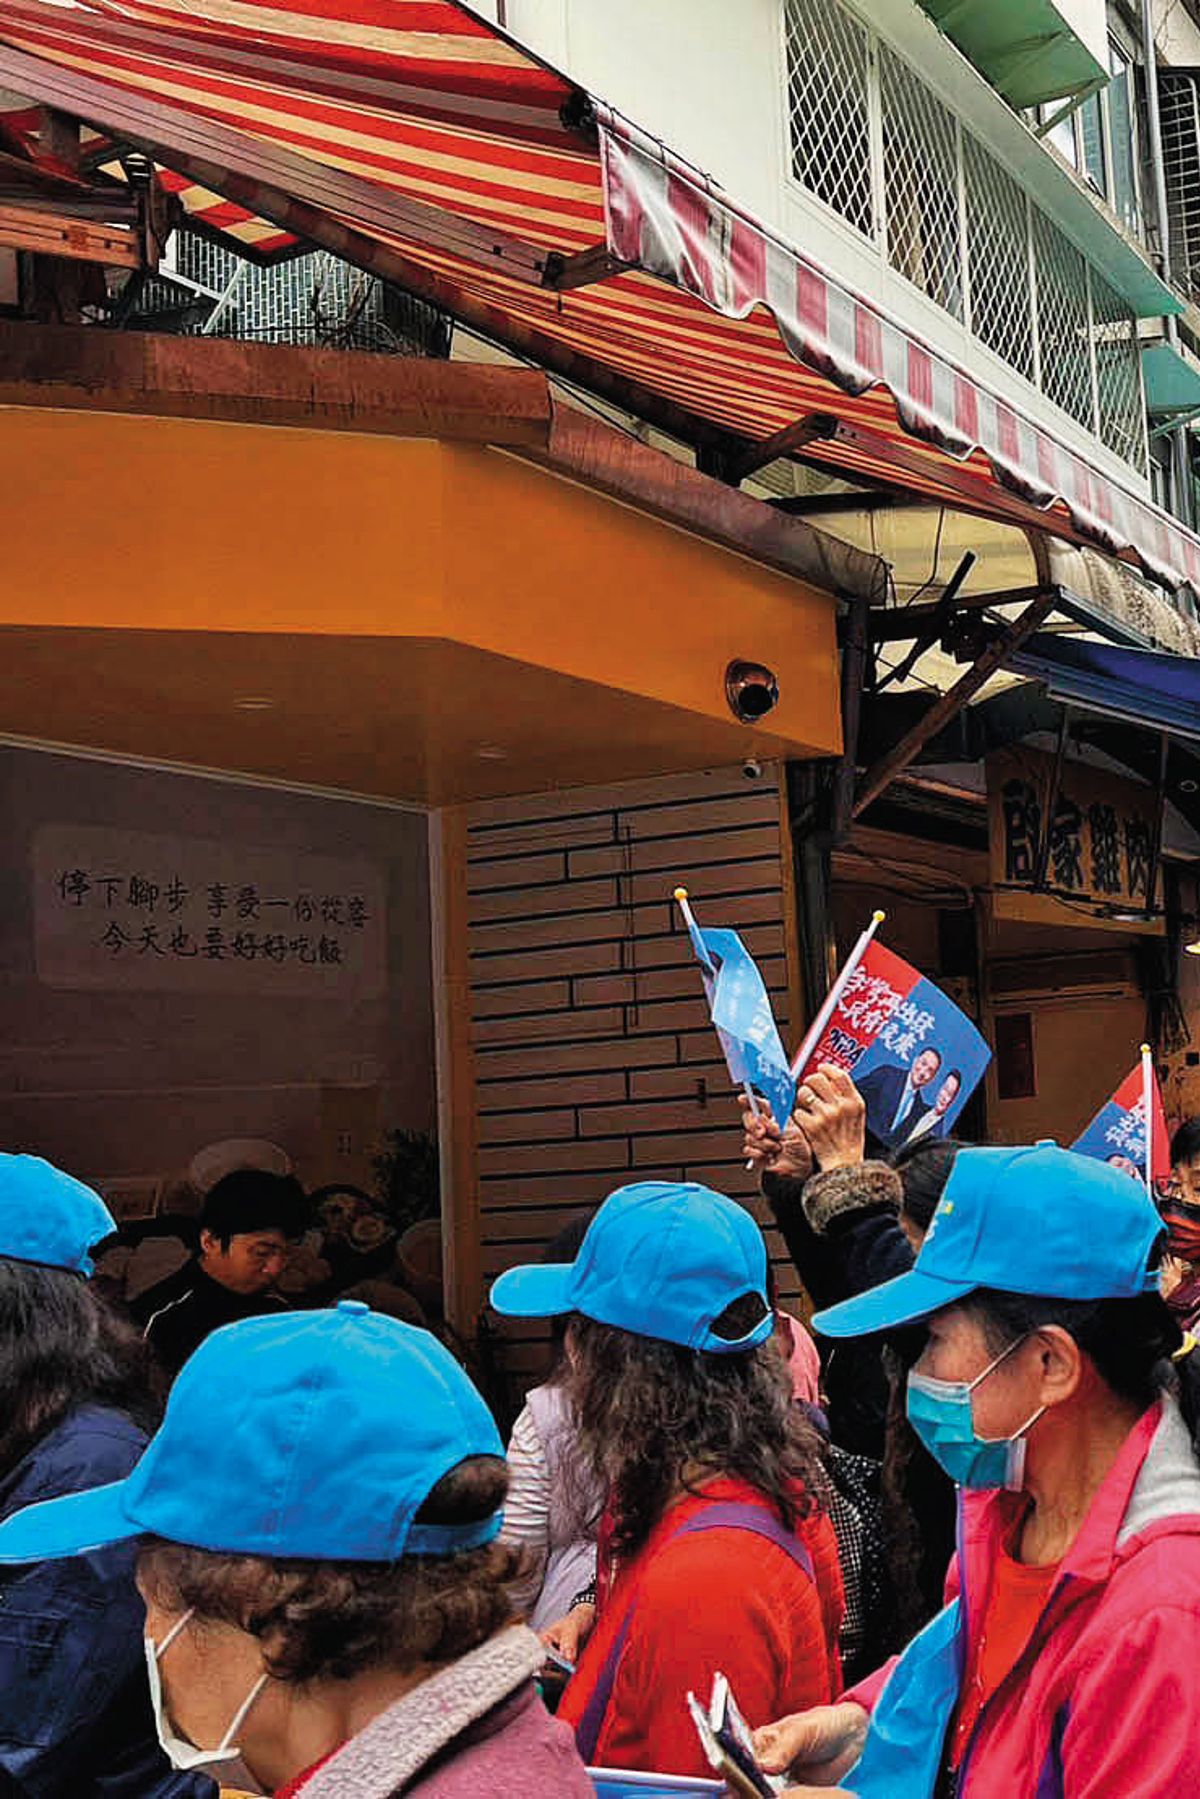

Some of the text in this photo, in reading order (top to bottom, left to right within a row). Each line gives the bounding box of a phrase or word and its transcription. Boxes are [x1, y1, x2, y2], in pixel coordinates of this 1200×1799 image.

[101, 922, 345, 965] 今天也要好好吃飯
[828, 1028, 868, 1067] 2024
